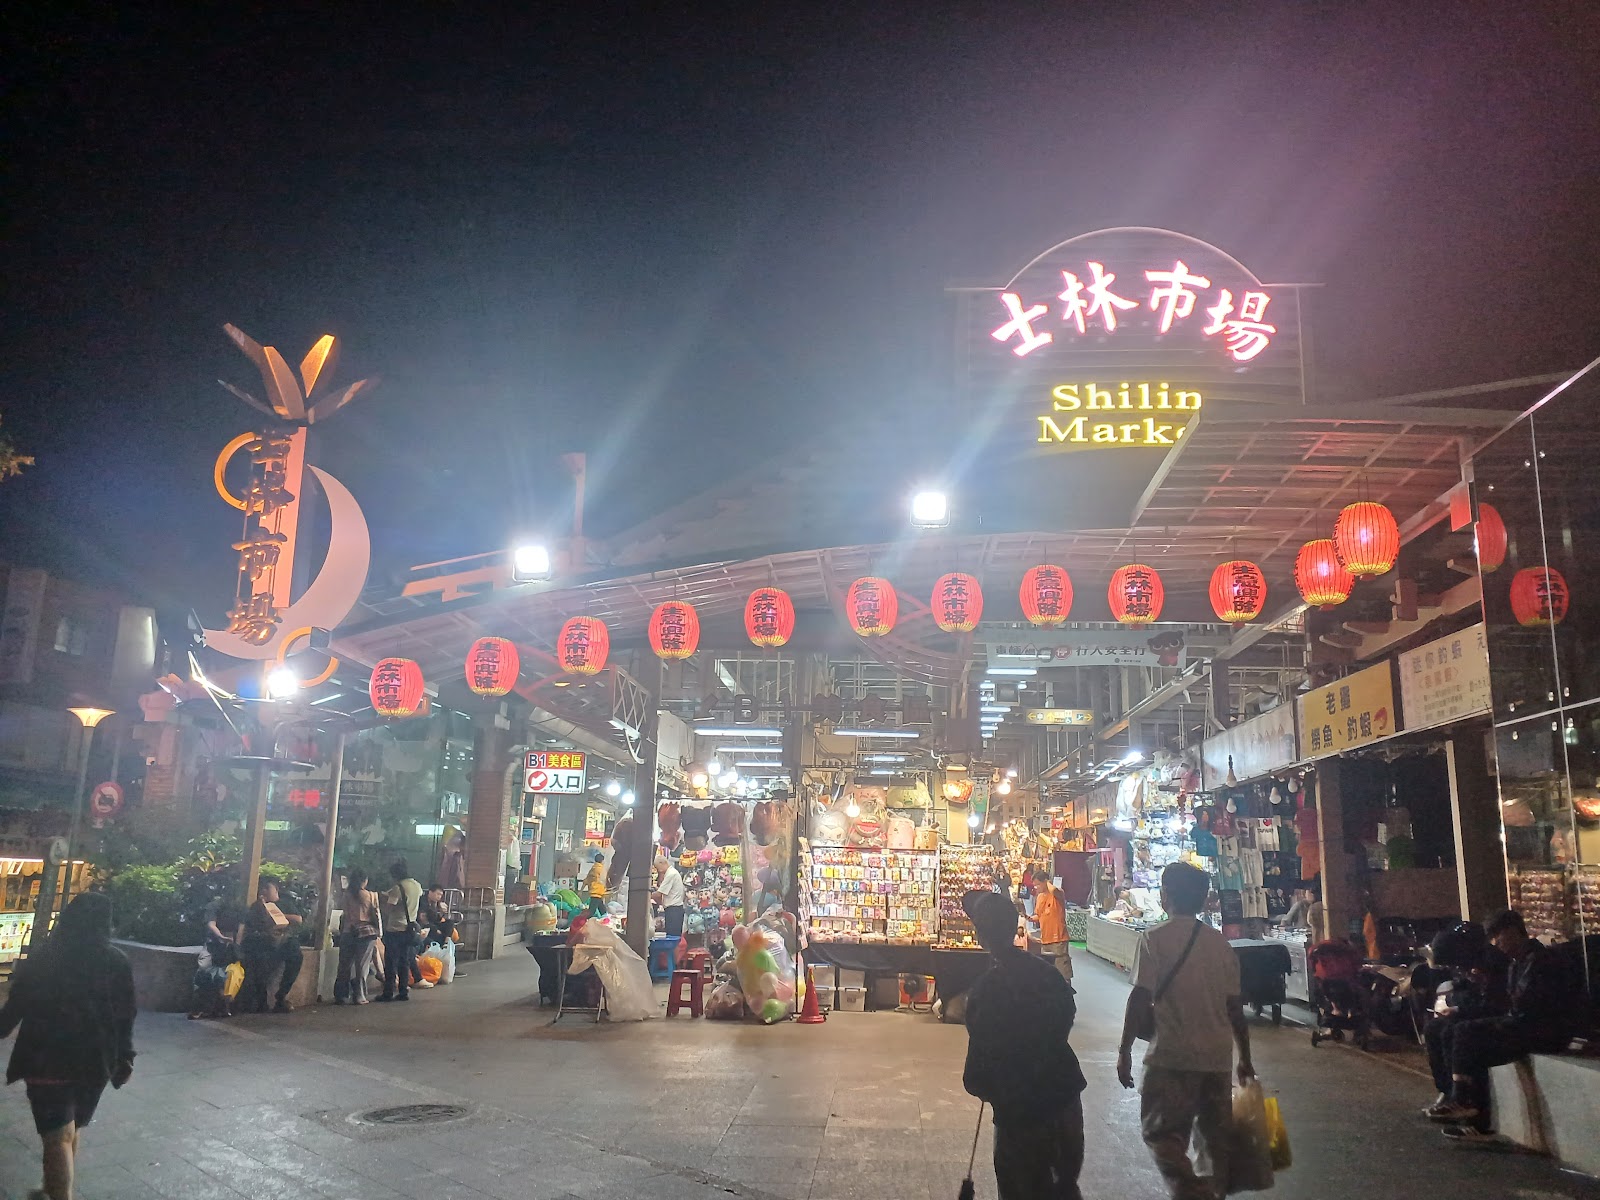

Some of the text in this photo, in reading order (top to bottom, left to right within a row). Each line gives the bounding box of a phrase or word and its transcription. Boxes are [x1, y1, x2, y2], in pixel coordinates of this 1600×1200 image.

[990, 260, 1277, 361] 士林市場
[1052, 382, 1202, 411] Shilin
[752, 593, 777, 636] 士林市場
[942, 577, 968, 623] 士林市場
[1125, 570, 1152, 617] 士林市場
[565, 622, 591, 666] 士林市場
[1076, 645, 1146, 657] 行人安全行
[375, 662, 403, 708] 士林市場
[549, 773, 581, 789] 入口
